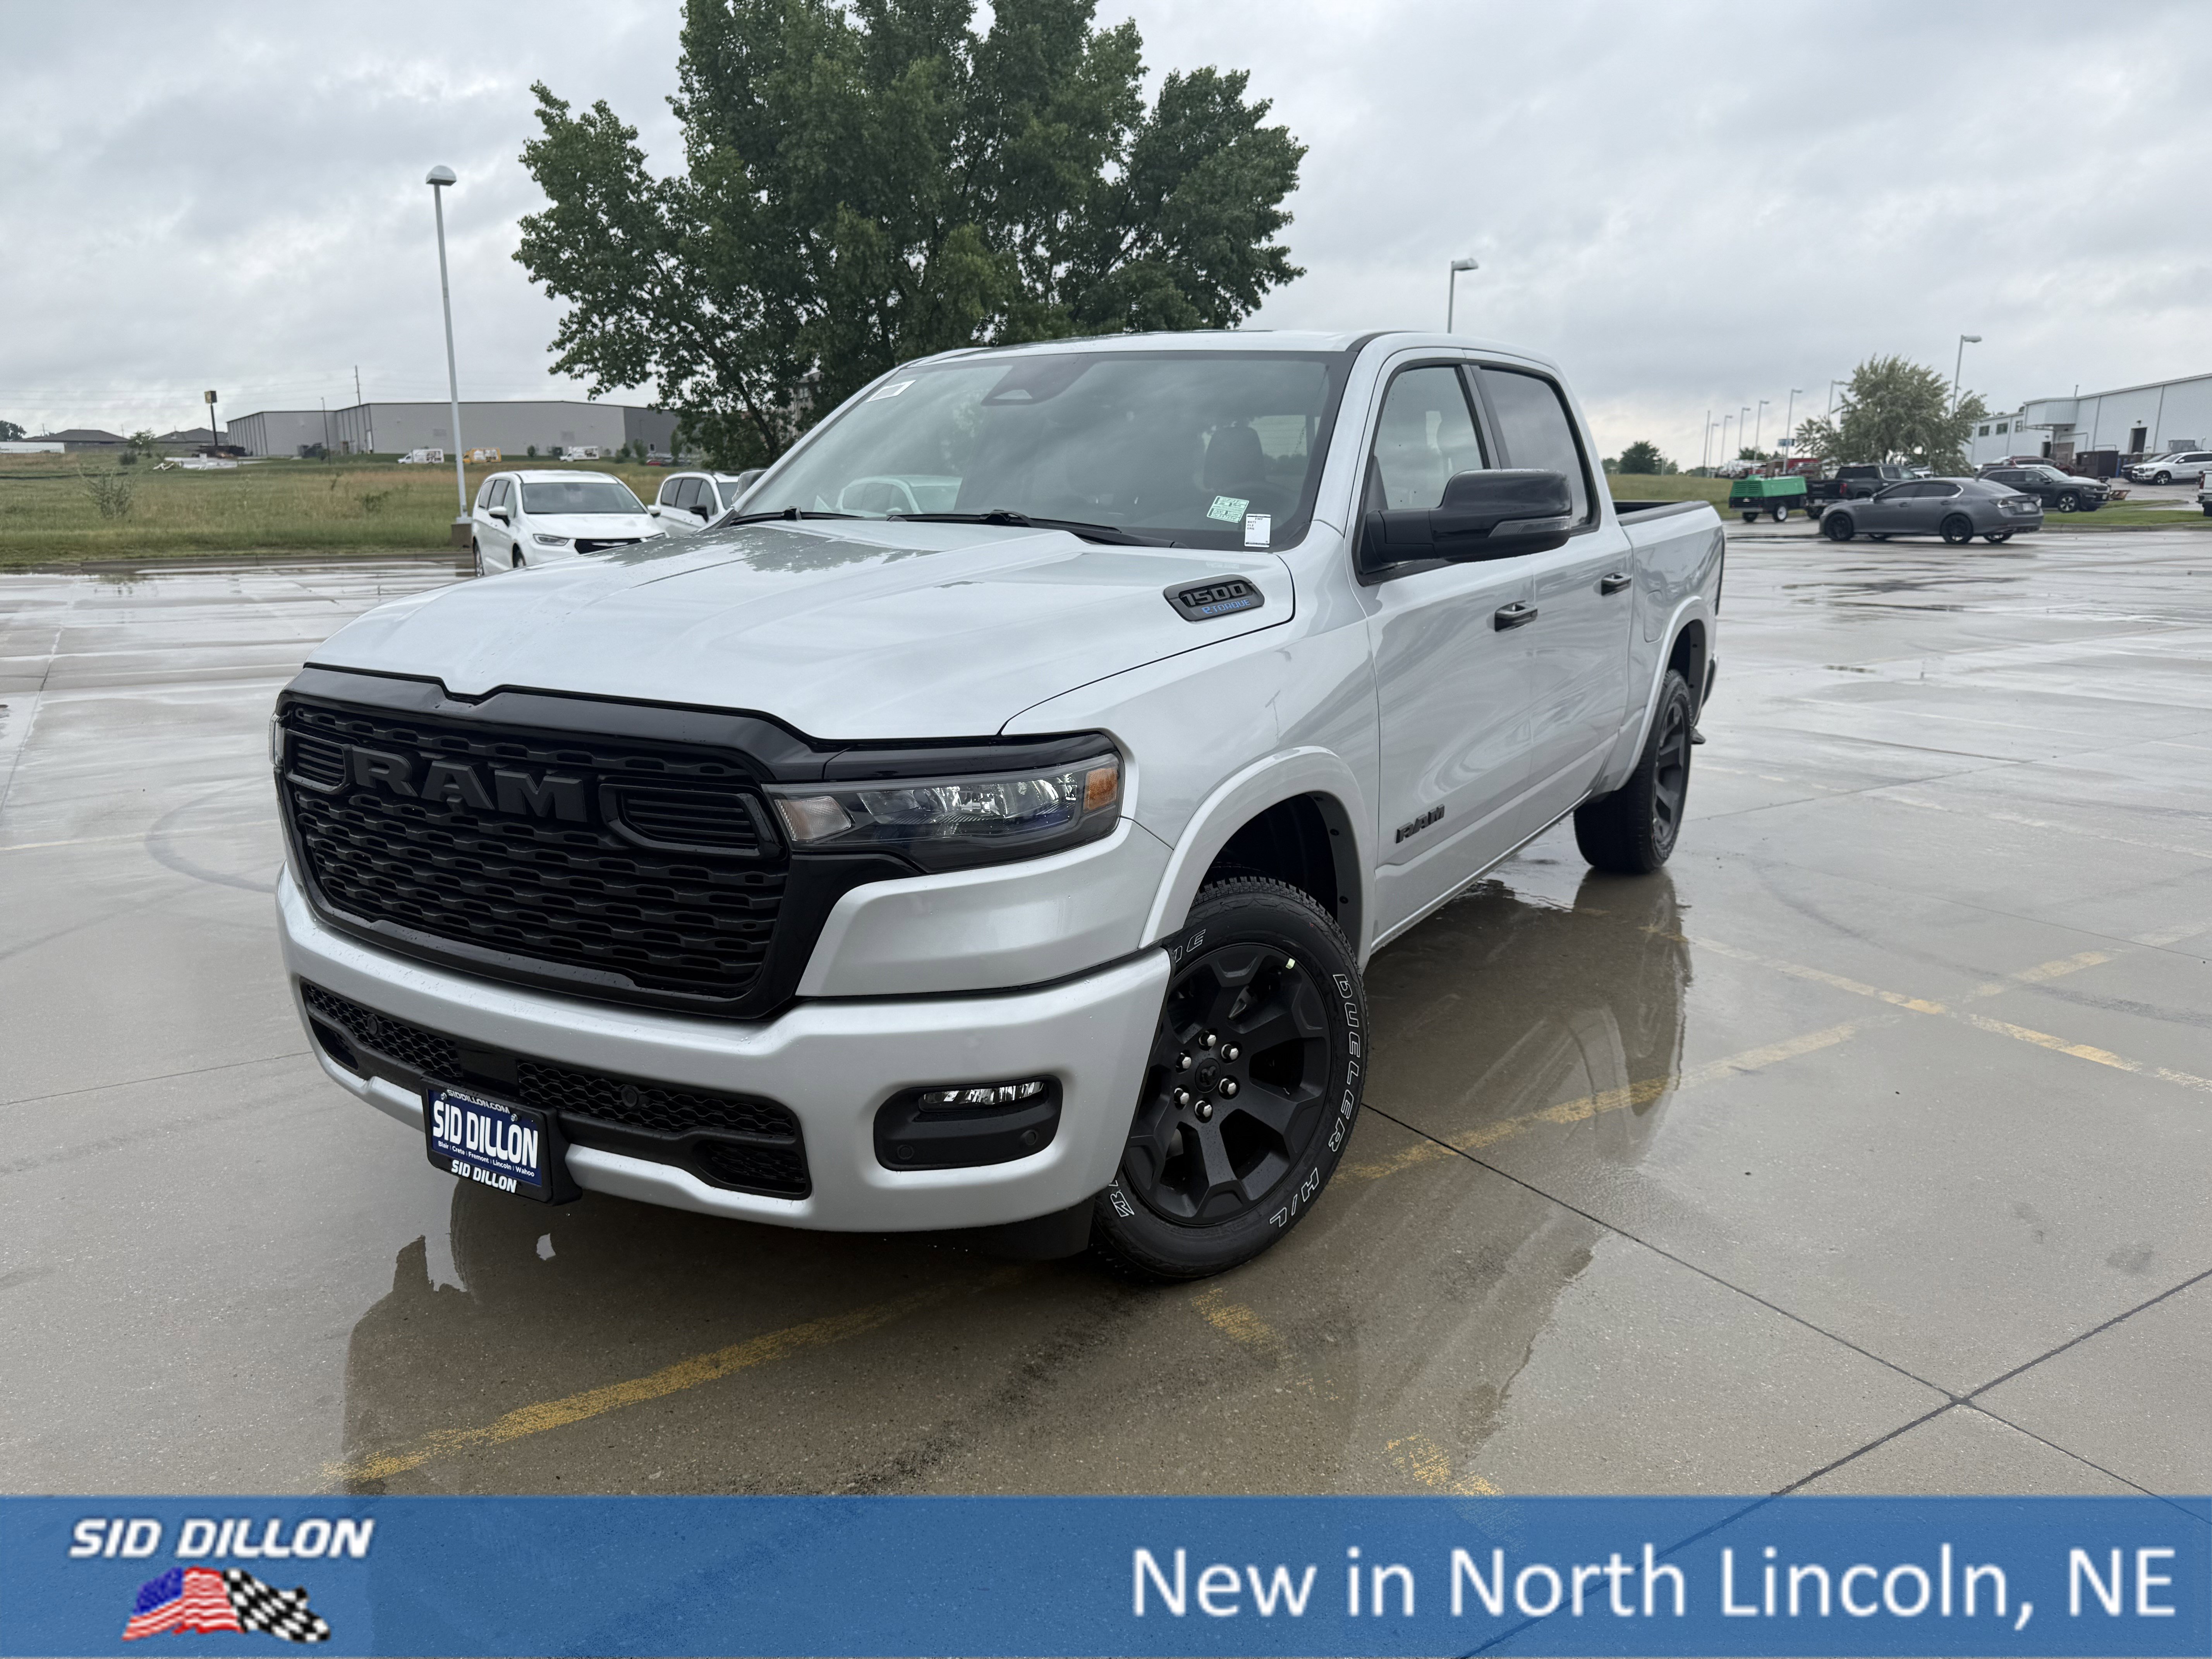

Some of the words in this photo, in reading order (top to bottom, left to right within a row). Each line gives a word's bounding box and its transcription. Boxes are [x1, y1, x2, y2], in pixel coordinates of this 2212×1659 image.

[1181, 583, 1247, 606] 1500
[352, 745, 587, 822] RAM
[1395, 804, 1445, 844] RAM
[1328, 974, 1360, 1152] DUELER
[447, 1089, 511, 1114] SIDDILLON.COM
[433, 1100, 462, 1145] SID
[466, 1111, 539, 1169] DILLON
[438, 1140, 449, 1149] Blair
[452, 1146, 465, 1155] Crete
[468, 1151, 489, 1164] Fremont
[493, 1159, 512, 1171] Lincoln
[515, 1166, 535, 1177] Wahoo
[451, 1159, 471, 1178] SID
[472, 1166, 517, 1194] DILLON
